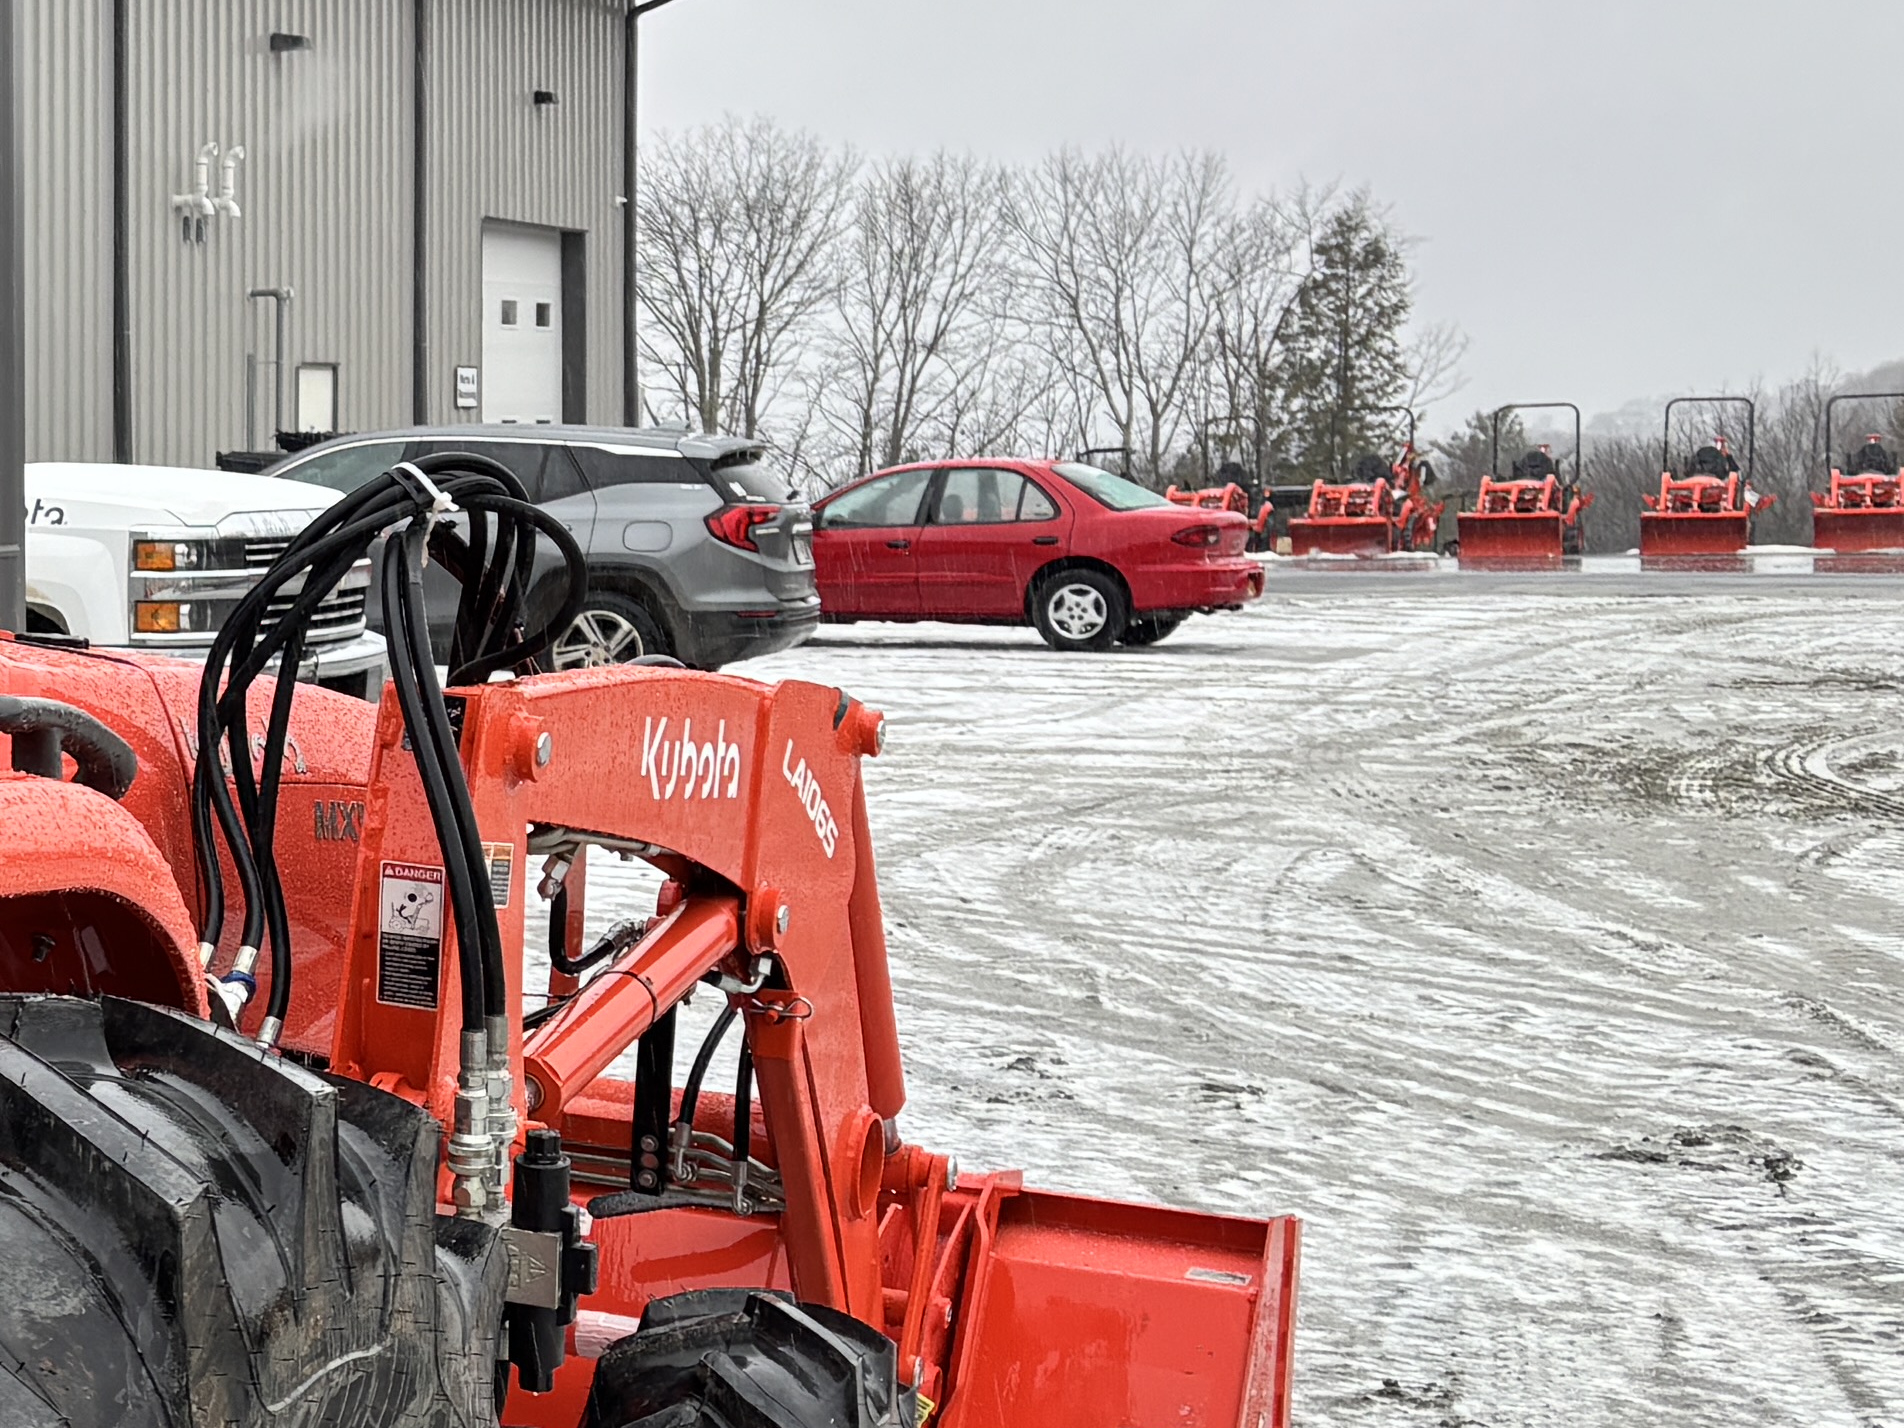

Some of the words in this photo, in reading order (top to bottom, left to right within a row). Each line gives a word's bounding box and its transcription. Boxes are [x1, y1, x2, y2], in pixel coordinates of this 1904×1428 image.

[641, 716, 741, 800] Kubota
[782, 738, 839, 859] LA1065
[395, 869, 442, 883] DANGER
